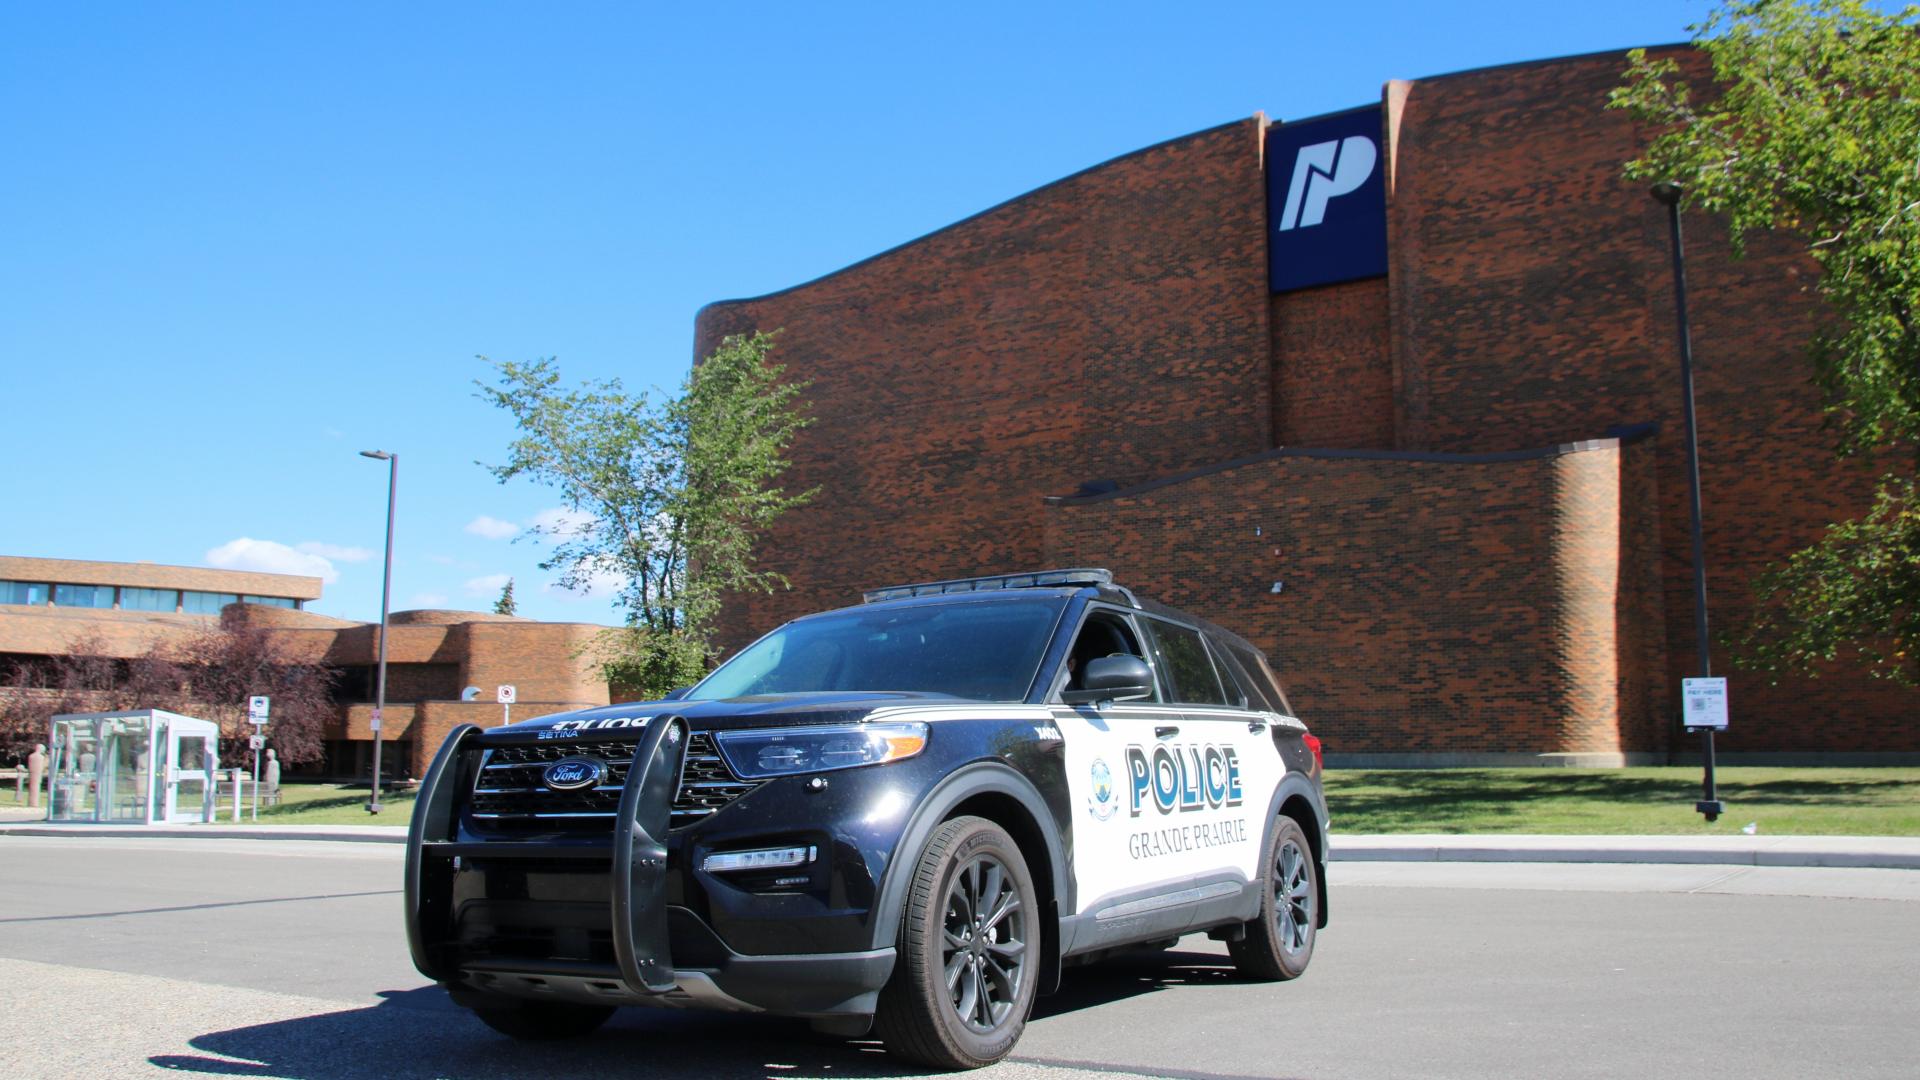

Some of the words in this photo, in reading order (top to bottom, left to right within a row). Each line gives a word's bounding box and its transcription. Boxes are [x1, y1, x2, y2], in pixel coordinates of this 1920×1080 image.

[538, 730, 578, 740] SETINA
[553, 764, 584, 781] Ford
[1125, 743, 1243, 818] POLICE
[1129, 827, 1192, 860] GRANDE
[1193, 819, 1247, 849] PRAIRIE
